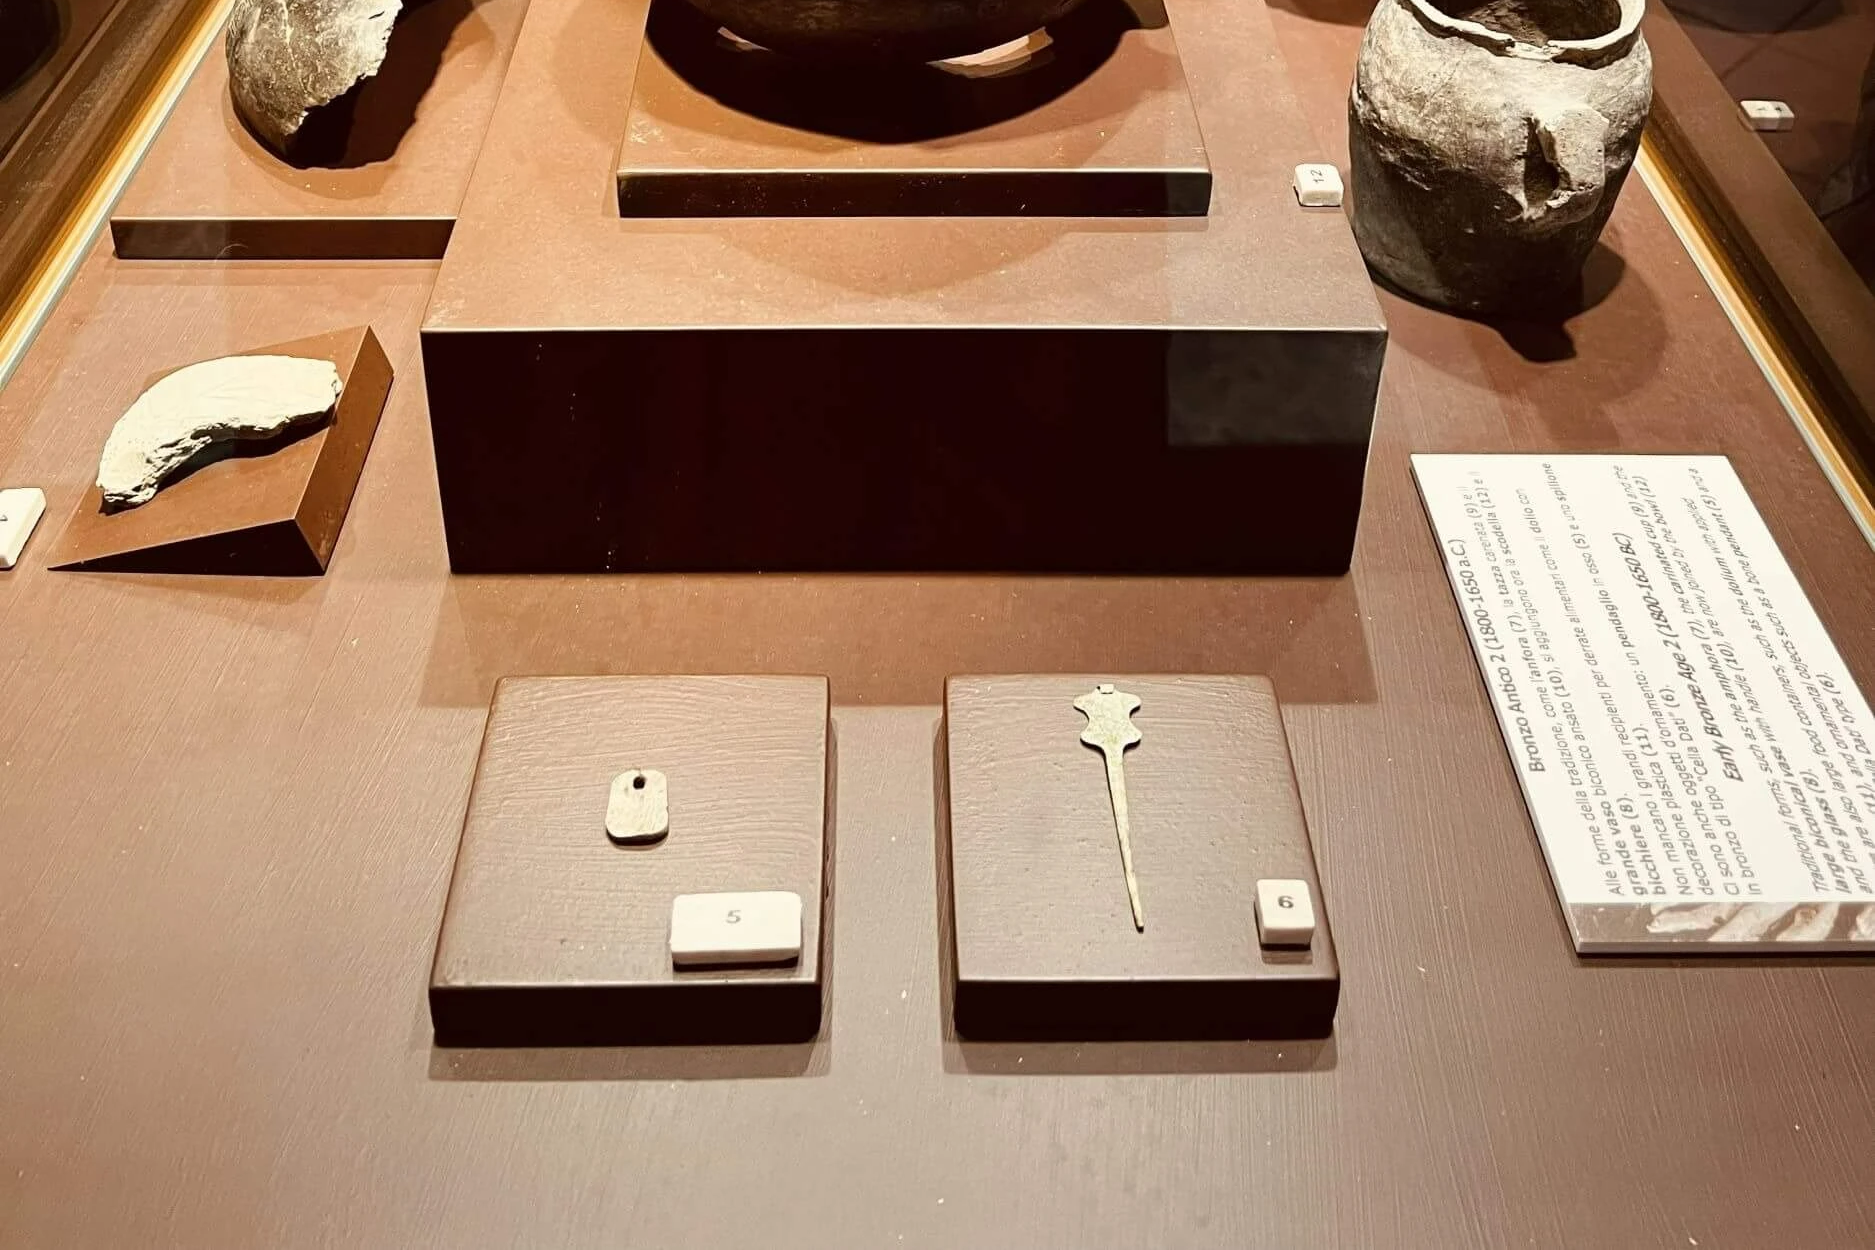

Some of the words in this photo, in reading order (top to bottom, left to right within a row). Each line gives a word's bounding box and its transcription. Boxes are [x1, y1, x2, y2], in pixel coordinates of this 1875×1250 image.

[1310, 169, 1325, 184] 12
[1542, 463, 1568, 502] spillone
[1613, 465, 1629, 481] the
[1687, 467, 1700, 475] a
[1689, 475, 1711, 493] and
[1462, 493, 1474, 501] e
[1474, 487, 1497, 510] (12)
[1515, 489, 1534, 506] con
[1618, 481, 1639, 500] and
[1632, 476, 1657, 499] (12)
[1464, 503, 1484, 519] (9)
[1560, 504, 1577, 522] uno
[1628, 502, 1651, 518] (9)
[1643, 499, 1669, 528] bowl
[1681, 497, 1711, 532] applied
[1700, 495, 1723, 512] (5)
[1486, 512, 1513, 556] scodella
[1523, 507, 1543, 534] dolio
[1568, 523, 1580, 531] e
[1640, 519, 1659, 540] cup
[1473, 522, 1498, 563] carenata
[1570, 533, 1591, 550] (5)
[1611, 532, 1638, 557] BC)
[1660, 527, 1678, 545] the
[1701, 533, 1722, 555] with
[1711, 513, 1750, 559] pendant
[1447, 539, 1472, 568] a.C.)
[1504, 558, 1517, 567] la
[1539, 544, 1559, 571] come
[1582, 552, 1600, 575] osso
[1669, 545, 1686, 559] by
[1491, 566, 1511, 596] tazza
[1510, 569, 1525, 587] ora
[1592, 577, 1606, 587] in
[1647, 541, 1686, 596] carinated
[1673, 560, 1707, 594] joined
[1714, 557, 1745, 597] dolium
[1738, 559, 1761, 586] bone
[1502, 598, 1515, 609] la
[1549, 574, 1582, 625] alimentari
[1624, 557, 1681, 640] (1800-1650
[1751, 586, 1767, 596] a
[1757, 596, 1775, 610] as
[1459, 570, 1506, 651] (1800-1650
[1598, 590, 1637, 649] pendaglio
[1677, 597, 1698, 615] the
[1693, 593, 1716, 618] now
[1736, 598, 1756, 617] the
[1506, 612, 1528, 634] (7),
[1517, 589, 1551, 651] aggiungono
[1686, 619, 1711, 641] (7),
[1706, 619, 1726, 638] are
[1746, 618, 1764, 633] as
[1764, 612, 1792, 638] such
[1488, 653, 1507, 664] 2
[1538, 653, 1556, 663] si
[1573, 627, 1599, 667] derrate
[1625, 652, 1641, 667] un
[1662, 639, 1683, 652] 2
[1715, 641, 1746, 673] (10),
[1753, 634, 1779, 662] such
[1672, 652, 1699, 684] Age
[1700, 643, 1738, 702] amphora
[1781, 639, 1812, 681] objects
[1497, 667, 1526, 715] Antico
[1546, 667, 1572, 698] (10),
[1590, 669, 1611, 689] per
[1815, 672, 1843, 695] (6).
[1536, 687, 1558, 719] come
[1658, 684, 1682, 709] (6).
[1734, 674, 1764, 715] handle
[1771, 664, 1814, 727] containers,
[1561, 702, 1587, 742] ansato
[1597, 692, 1633, 747] recipienti
[1687, 683, 1725, 740] Bronze
[1729, 703, 1750, 724] the
[1800, 681, 1850, 751] ornamental
[1831, 697, 1857, 725] type
[1632, 724, 1660, 757] (11).
[1740, 725, 1759, 742] as
[1753, 717, 1779, 743] with
[1801, 728, 1831, 759] food
[1515, 716, 1547, 773] Bronzo
[1551, 722, 1584, 787] tradizione,
[1578, 745, 1608, 797] biconico
[1621, 750, 1653, 790] grandi
[1711, 739, 1745, 783] Early
[1747, 744, 1774, 775] such
[1769, 745, 1796, 779] vase
[1837, 751, 1865, 778] and
[1649, 762, 1683, 810] plastica
[1666, 751, 1699, 797] oggetti
[1799, 769, 1827, 795] (8).
[1820, 760, 1849, 794] large
[1575, 790, 1597, 822] della
[1616, 793, 1641, 821] (8).
[1704, 785, 1726, 811] tipo
[1766, 778, 1796, 820] forms,
[1839, 796, 1865, 824] also
[1600, 801, 1623, 837] vaso
[1690, 800, 1718, 841] anche
[1714, 815, 1733, 828] di
[1783, 780, 1832, 850] biconical
[1814, 796, 1850, 839] glass
[1588, 825, 1615, 867] forme
[1645, 801, 1681, 863] mancano
[1855, 826, 1875, 849] are
[1630, 824, 1668, 896] bicchiere
[1671, 814, 1716, 897] decorazione
[1709, 844, 1734, 879] sono
[1724, 831, 1756, 879] bronzo
[1782, 821, 1832, 894] Traditional
[1836, 840, 1859, 864] the
[1614, 840, 1650, 897] grande
[1672, 867, 1695, 897] Non
[1821, 852, 1853, 895] large
[1846, 865, 1871, 895] and
[1604, 870, 1627, 897] Alle
[1723, 882, 1742, 897] Ci
[1747, 883, 1764, 896] in
[1277, 895, 1294, 909] 6
[725, 909, 742, 924] 5
